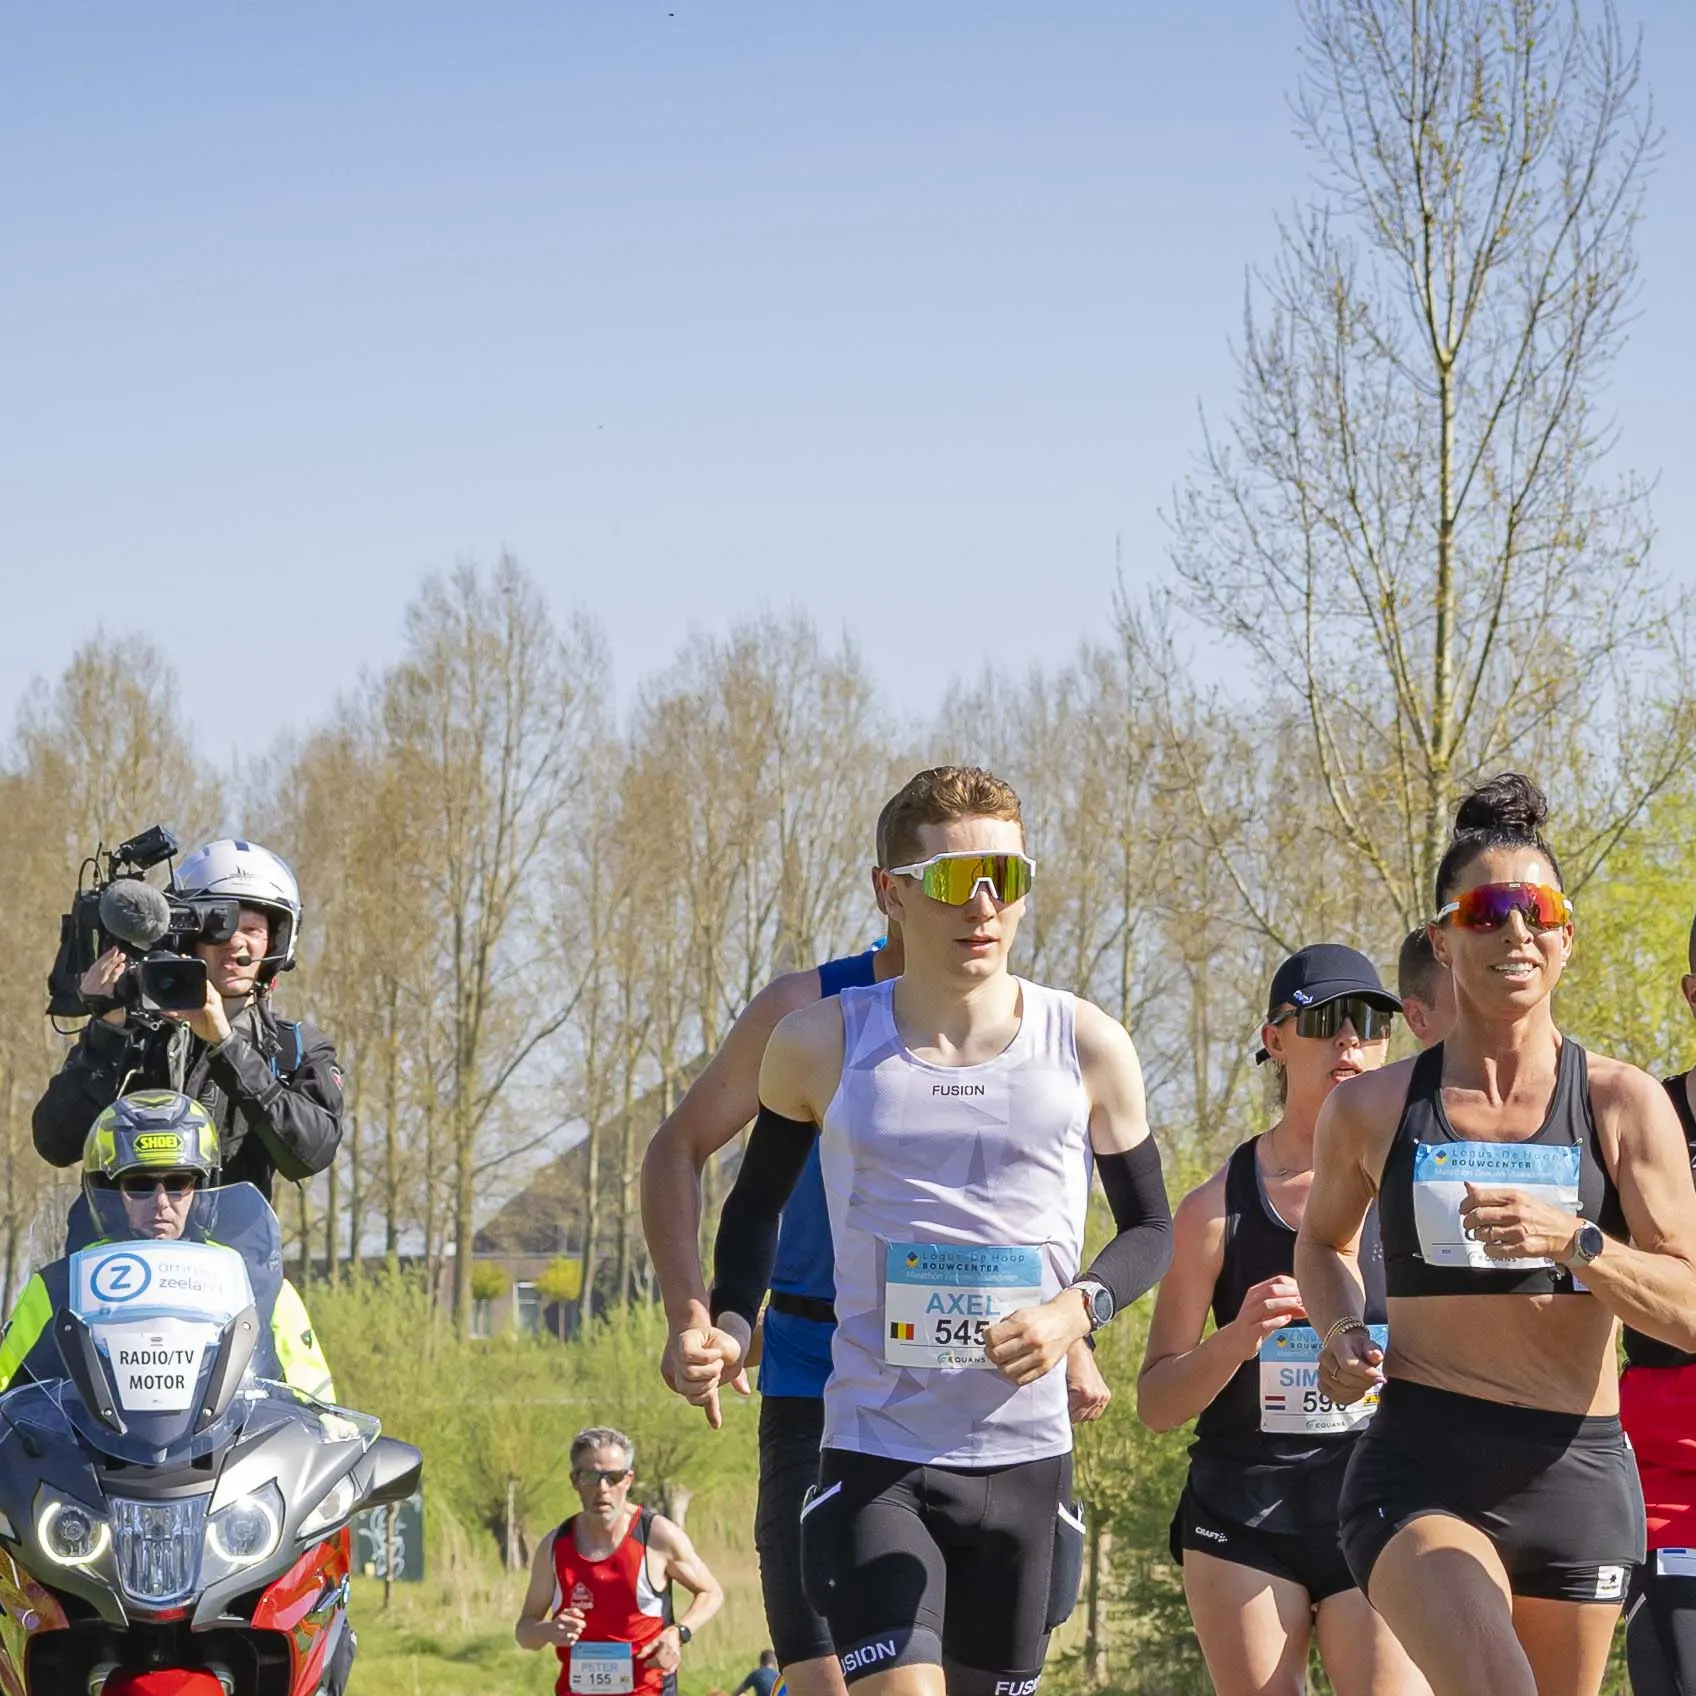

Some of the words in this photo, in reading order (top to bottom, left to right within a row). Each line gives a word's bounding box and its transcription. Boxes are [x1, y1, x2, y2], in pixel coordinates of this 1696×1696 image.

[932, 1085, 985, 1096] FUSION
[1452, 1159, 1532, 1169] BOUWCENTER
[922, 1263, 1000, 1273] BOUWCENTER
[109, 1264, 132, 1290] Z
[925, 1293, 1001, 1316] AXEL
[119, 1350, 195, 1366] RADIO/TV
[129, 1374, 185, 1390] MOTOR
[589, 1673, 612, 1685] 155
